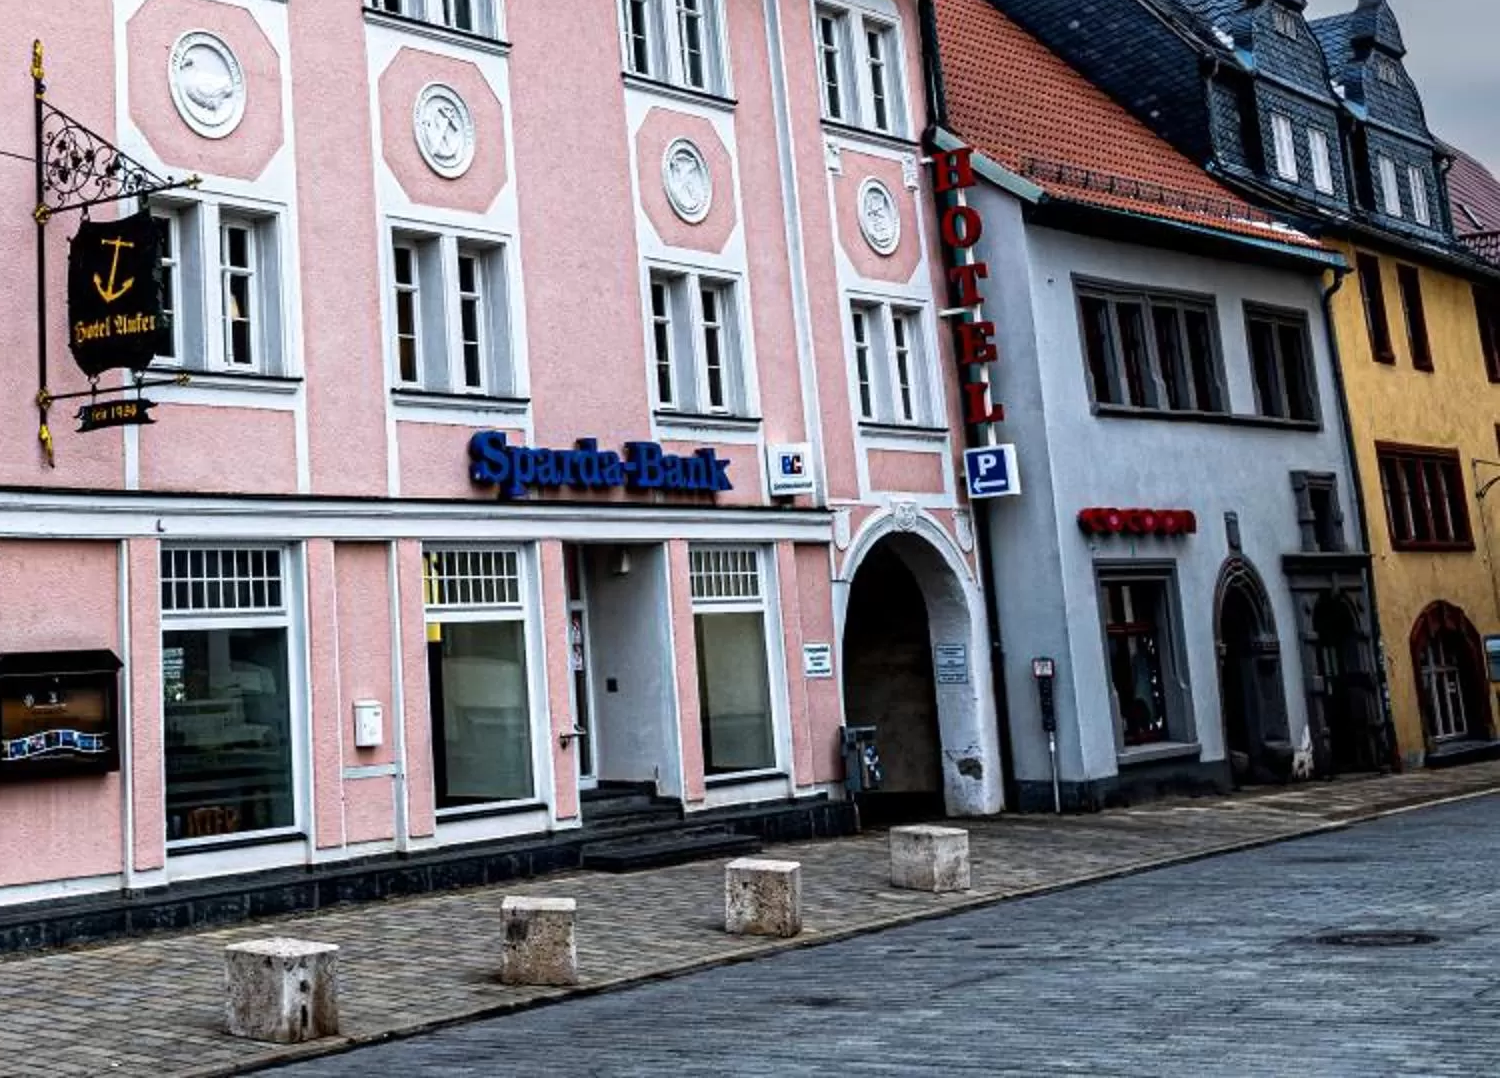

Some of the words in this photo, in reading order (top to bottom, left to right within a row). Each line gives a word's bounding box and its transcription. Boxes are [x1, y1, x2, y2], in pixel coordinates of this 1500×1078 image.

[931, 147, 1005, 423] HOTEL
[74, 316, 111, 343] Hotel
[469, 430, 733, 499] Sparda-Bank
[978, 453, 997, 476] P
